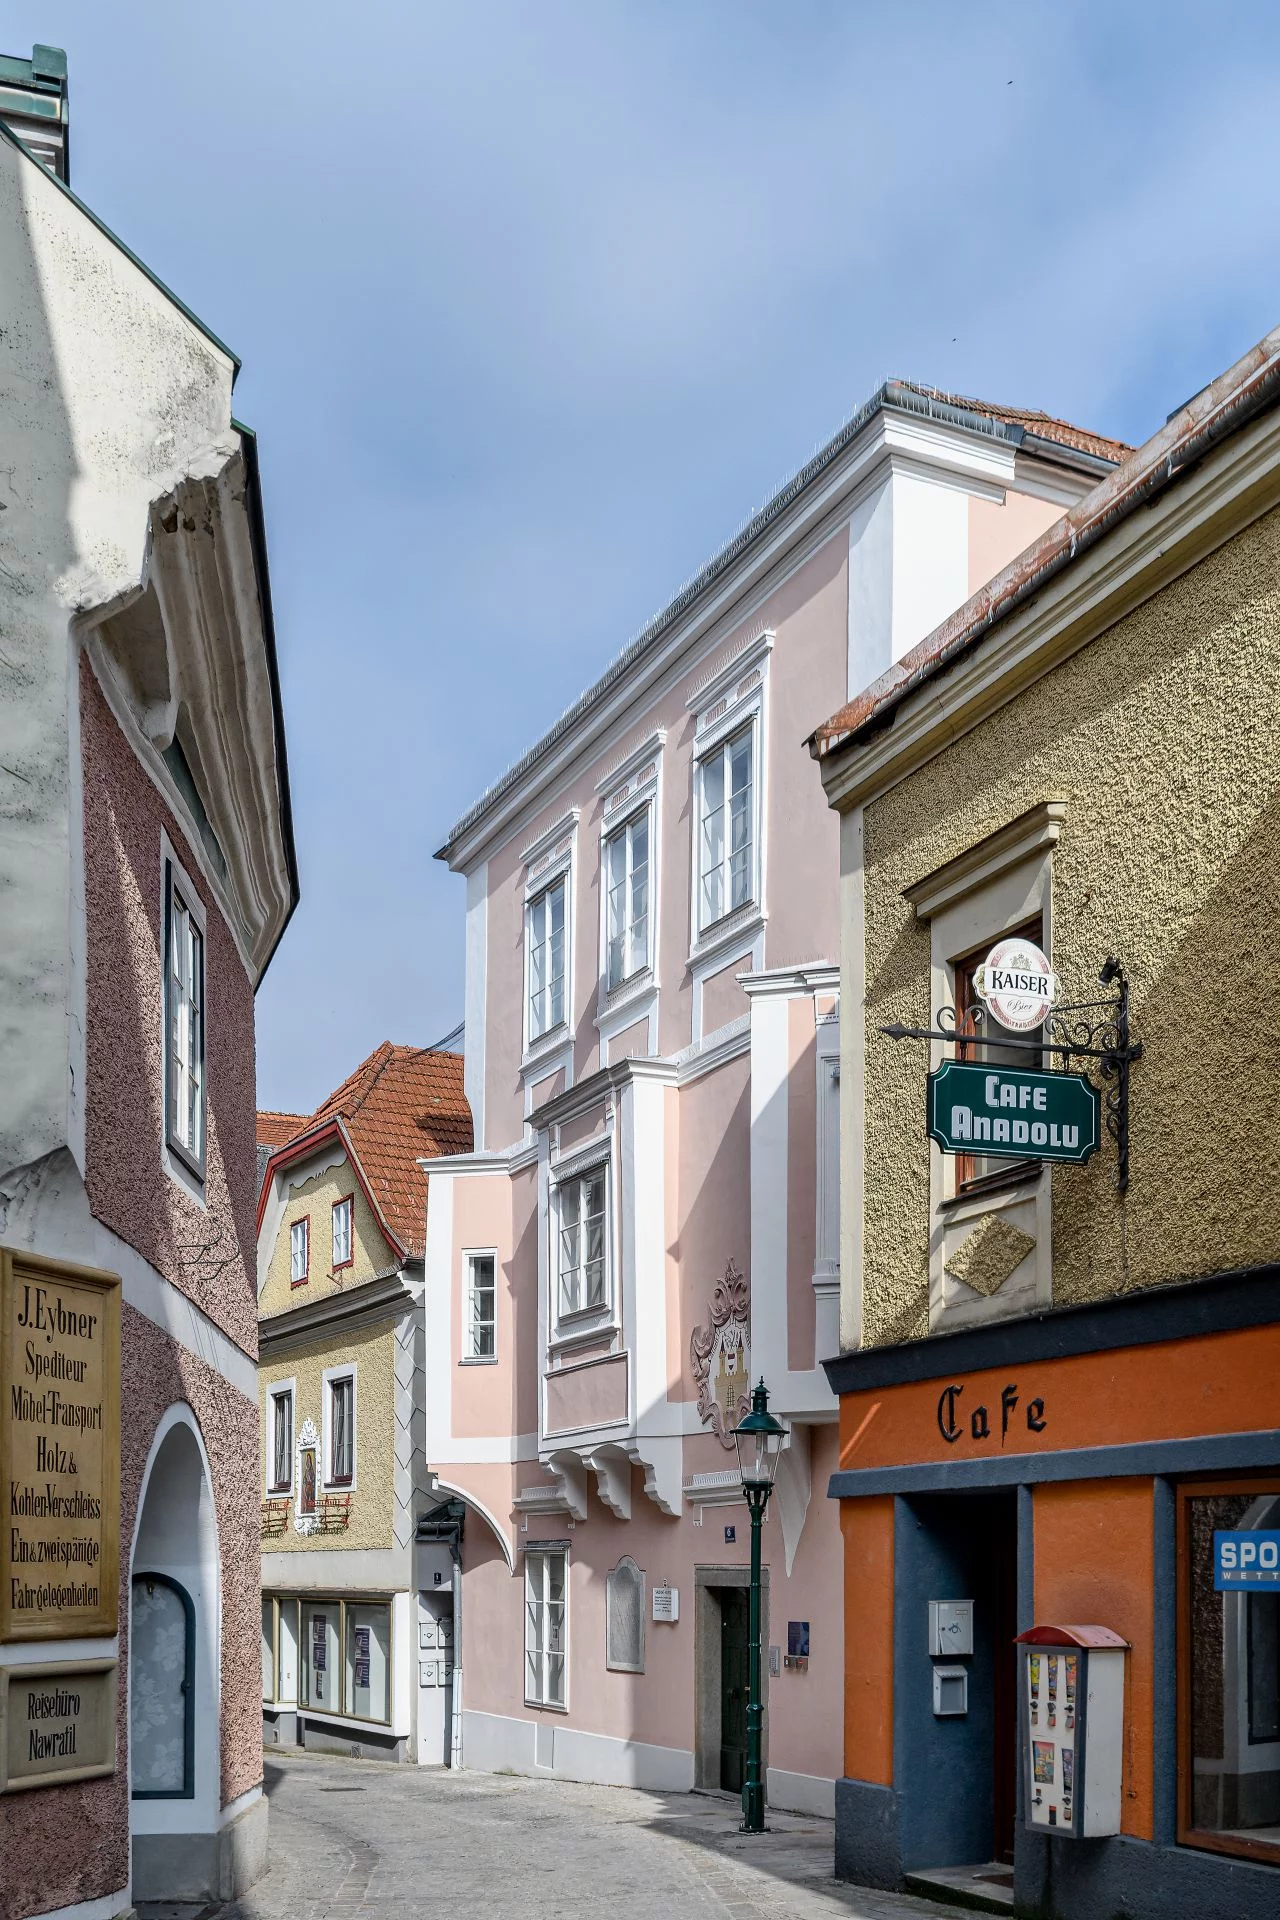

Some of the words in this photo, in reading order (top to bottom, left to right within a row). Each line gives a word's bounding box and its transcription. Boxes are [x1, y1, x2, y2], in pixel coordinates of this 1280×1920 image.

[992, 970, 1048, 996] KAISER
[985, 1075, 1047, 1111] CAFE
[25, 1341, 87, 1383] Spediteur
[12, 1385, 102, 1437] Möbel-Transport
[938, 1384, 1047, 1448] Cafe
[28, 1688, 81, 1720] Reisebüro
[28, 1723, 77, 1761] Nawratil
